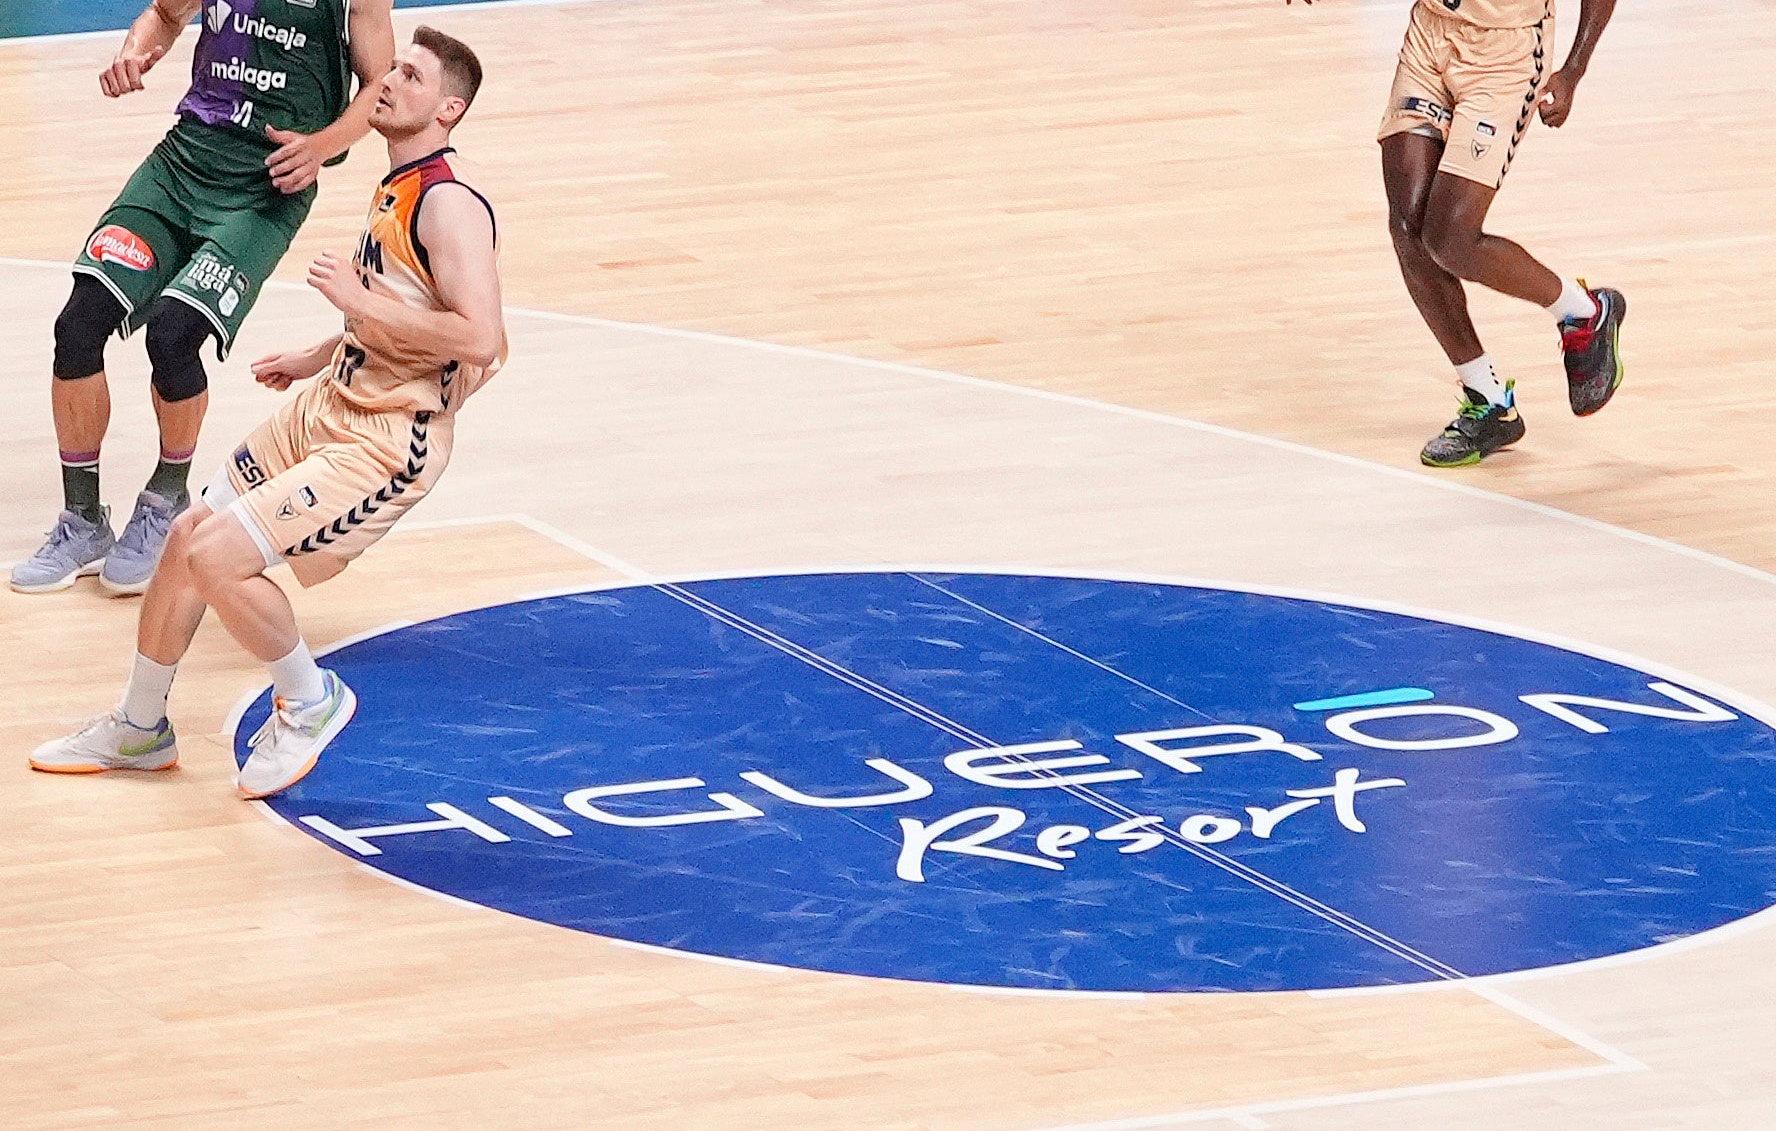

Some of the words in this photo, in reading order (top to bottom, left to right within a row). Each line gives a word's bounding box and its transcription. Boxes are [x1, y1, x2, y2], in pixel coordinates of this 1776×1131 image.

[233, 12, 307, 51] Unicaja
[297, 680, 1741, 858] HIGUERÓN
[896, 767, 1407, 884] Resort
